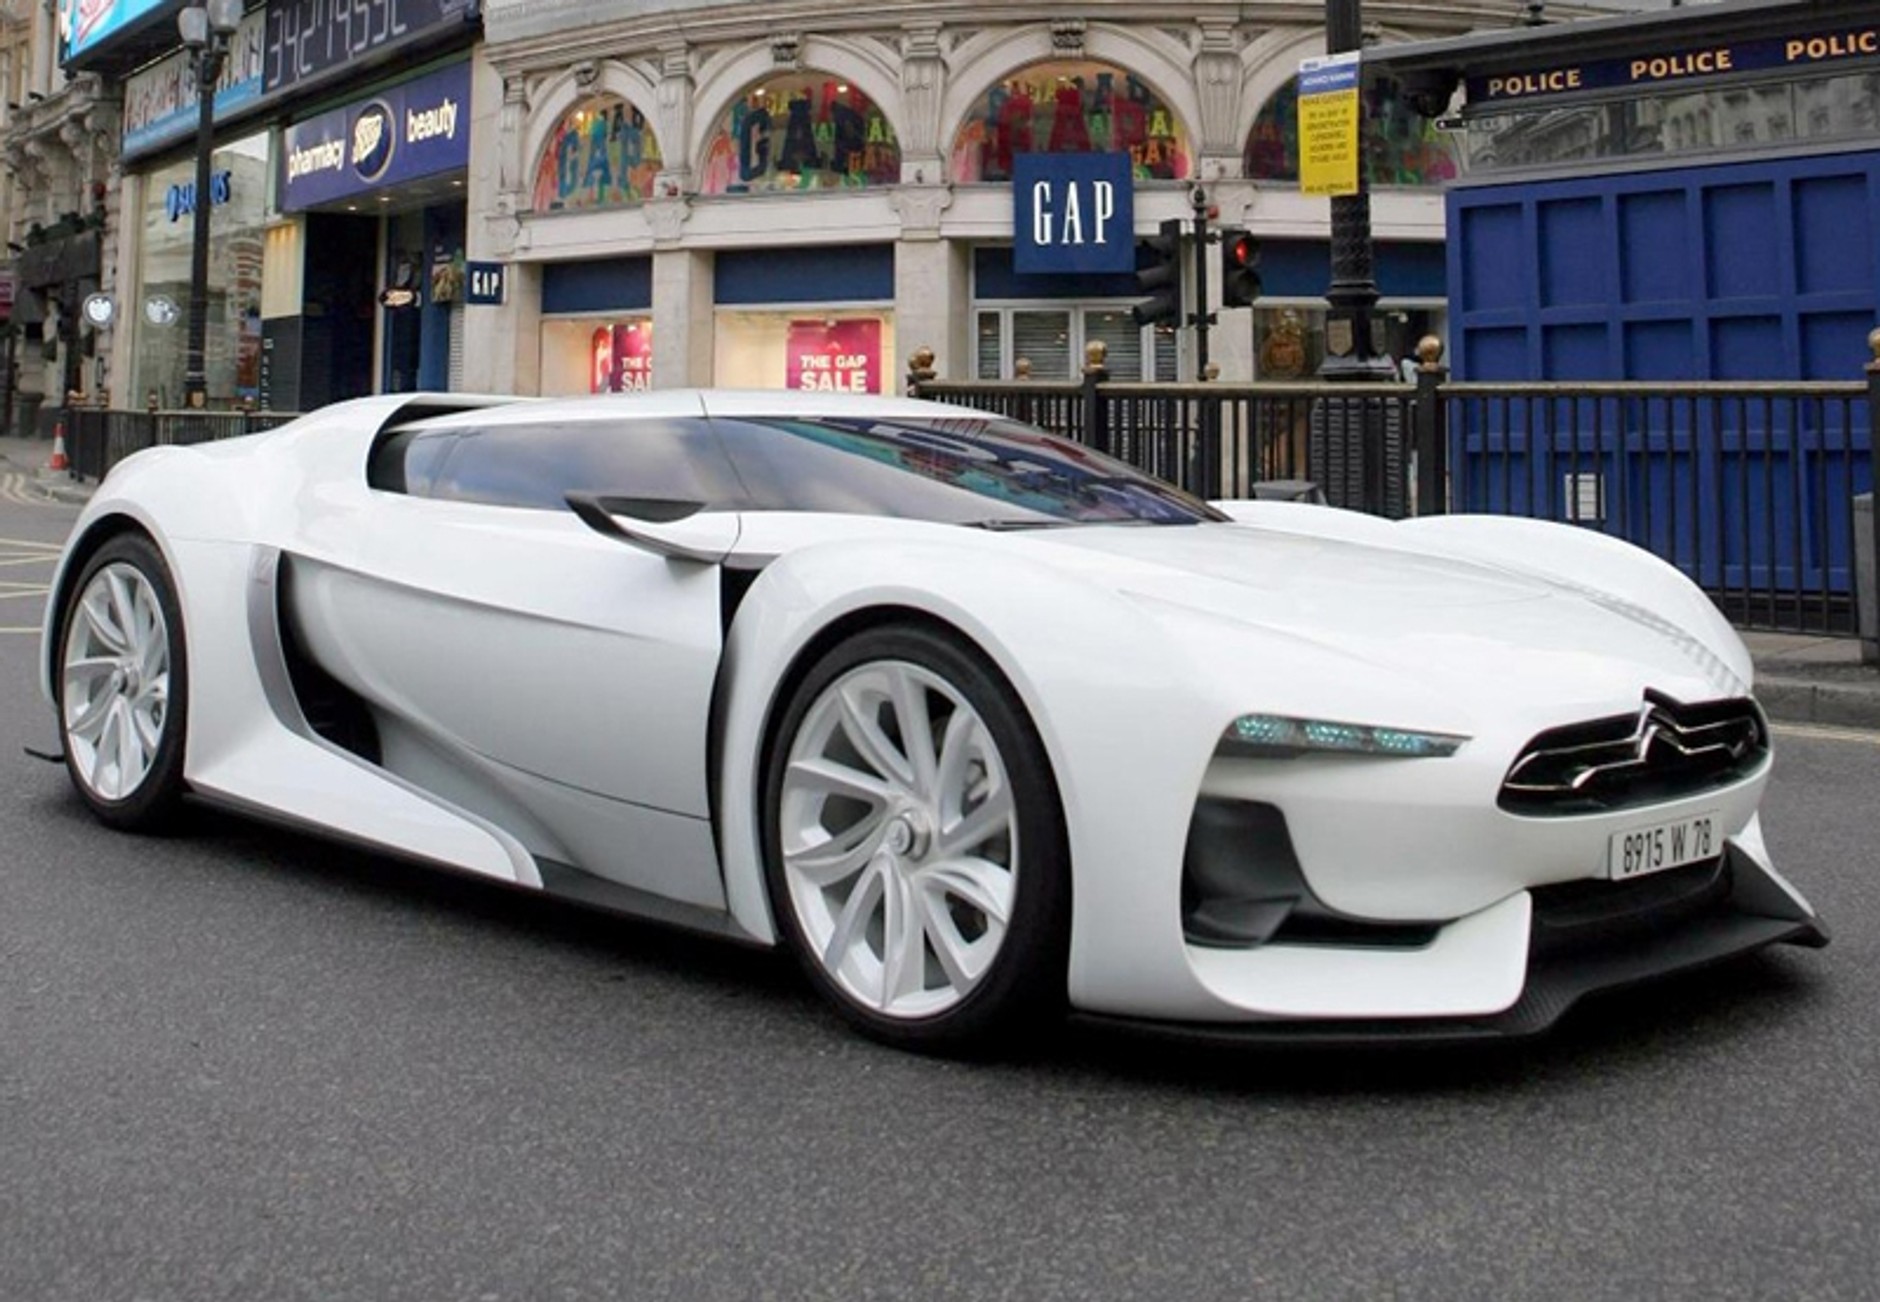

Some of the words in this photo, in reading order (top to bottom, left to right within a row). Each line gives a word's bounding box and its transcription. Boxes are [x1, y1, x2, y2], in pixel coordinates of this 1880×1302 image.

[1786, 30, 1878, 61] POLIC
[1631, 50, 1732, 79] POLICE
[1488, 69, 1581, 96] POLICE
[406, 97, 458, 143] beauty
[738, 99, 867, 182] GAP
[287, 138, 346, 184] pharmacy
[557, 115, 642, 198] GAP
[1034, 181, 1113, 245] GAP
[472, 270, 499, 296] GAP
[621, 357, 642, 369] THE
[801, 355, 831, 368] THE
[834, 355, 867, 368] GAP
[621, 371, 652, 392] SAL
[801, 370, 866, 392] SALE
[1623, 828, 1663, 873] 8915
[1670, 823, 1687, 863] W
[1692, 818, 1712, 857] 78
